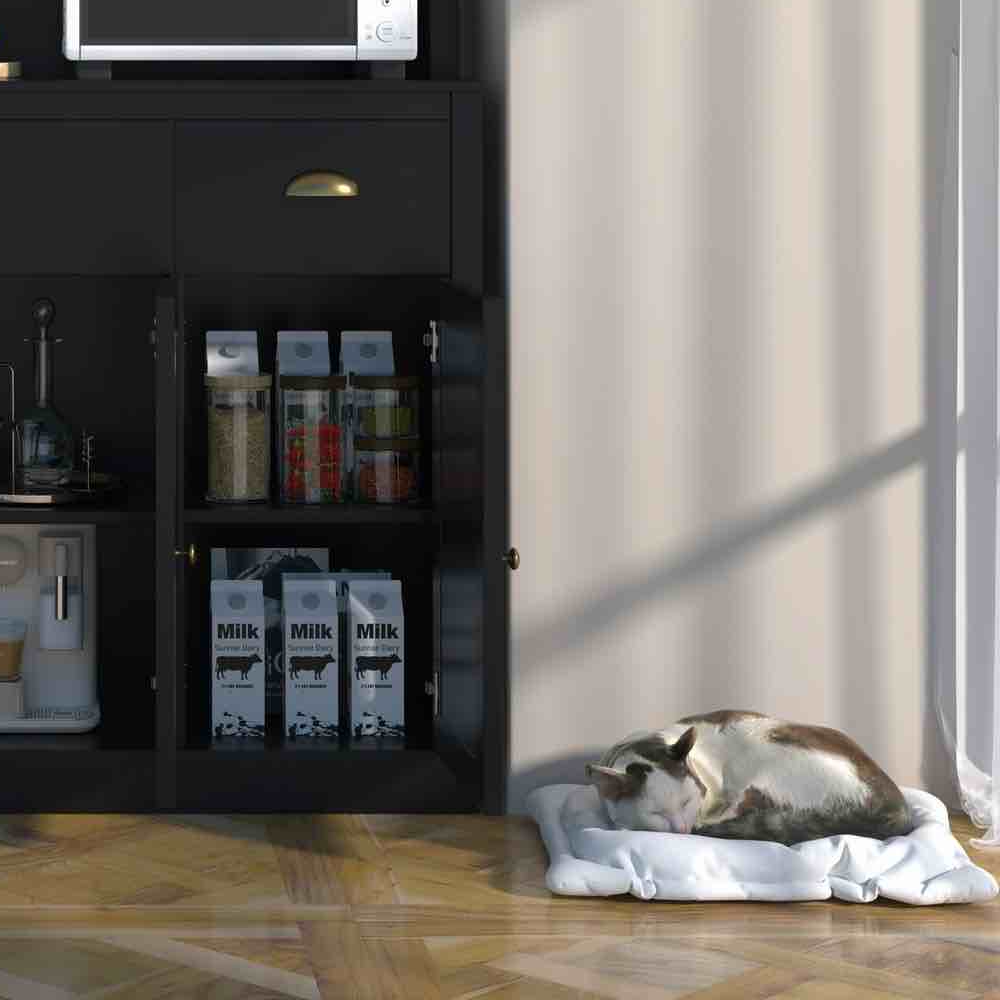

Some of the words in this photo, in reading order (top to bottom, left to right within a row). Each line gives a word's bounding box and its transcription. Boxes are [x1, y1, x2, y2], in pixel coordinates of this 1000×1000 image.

[217, 623, 260, 640] Milk
[290, 623, 333, 640] Milk
[356, 623, 399, 640] Milk
